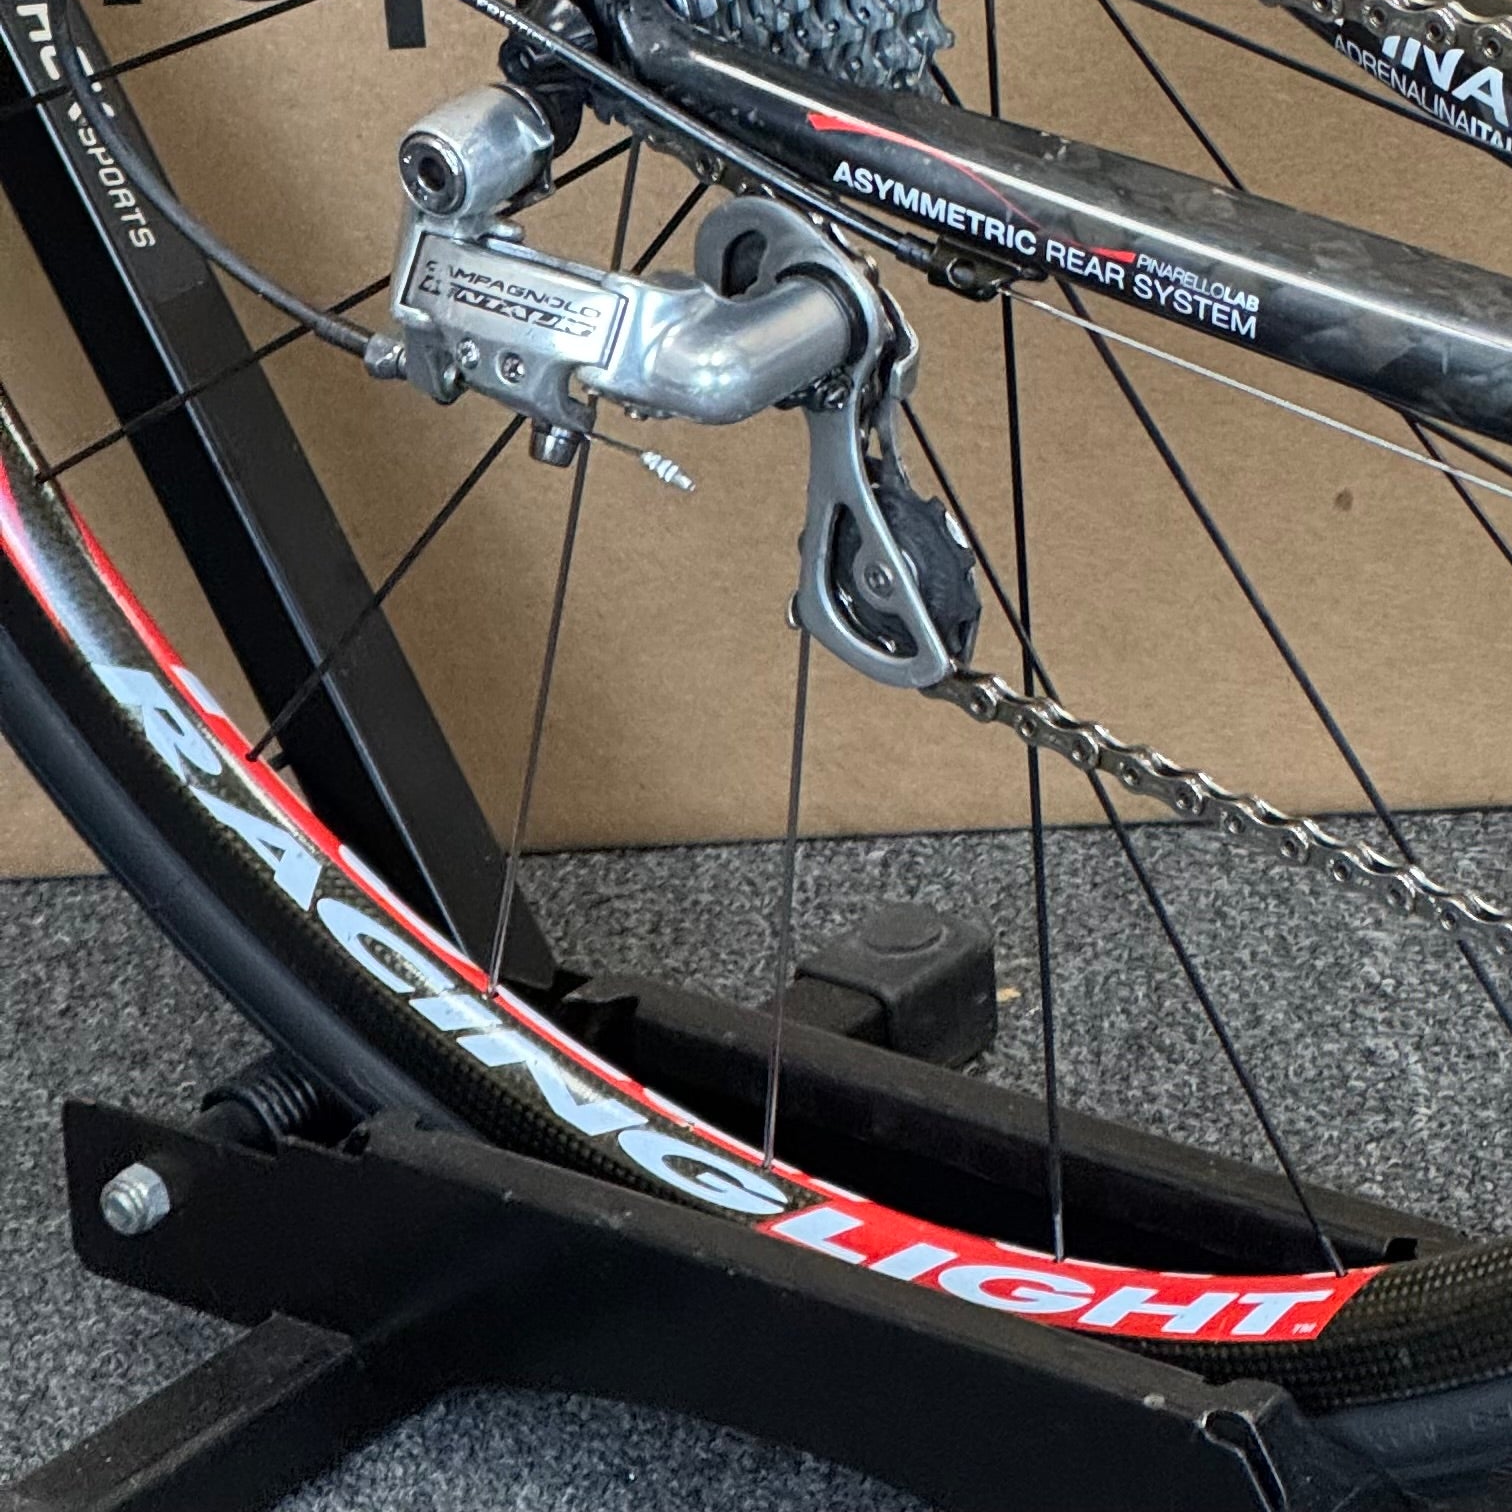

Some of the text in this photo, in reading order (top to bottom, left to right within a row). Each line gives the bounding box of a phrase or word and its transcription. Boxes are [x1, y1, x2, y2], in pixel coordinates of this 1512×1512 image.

[832, 160, 1258, 340] ASYMMETRIC REAR SYSTEM
[90, 662, 789, 1216] RACING
[770, 1207, 1333, 1336] LIGHT
